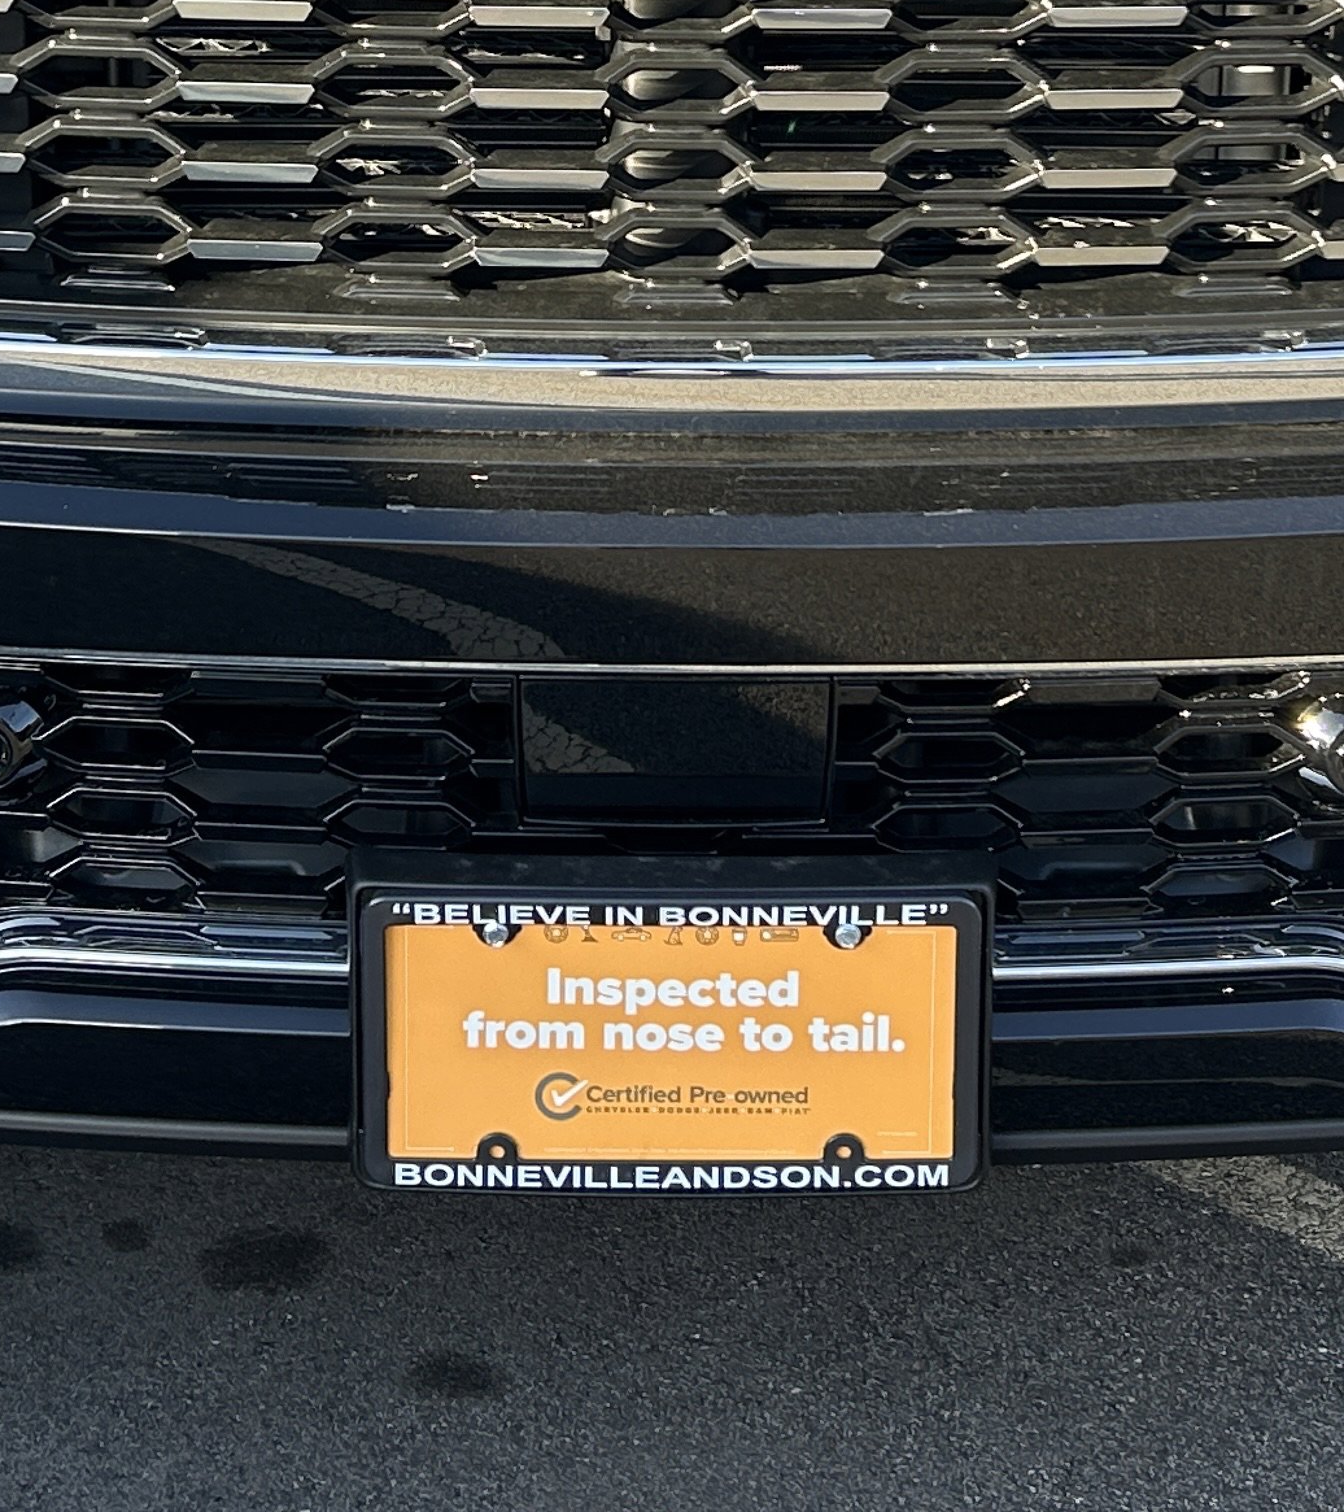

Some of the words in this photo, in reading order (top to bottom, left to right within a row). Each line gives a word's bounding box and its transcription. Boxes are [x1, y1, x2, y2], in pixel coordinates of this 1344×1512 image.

[604, 905, 645, 928] IN
[546, 967, 800, 1015] Inspected
[462, 1010, 586, 1049] from
[602, 1019, 726, 1051] nose
[738, 1016, 794, 1050] to
[807, 1011, 906, 1052] tail.
[585, 1085, 682, 1104] Certified
[393, 1163, 951, 1189] BONNEVILLEANDSON.COM
